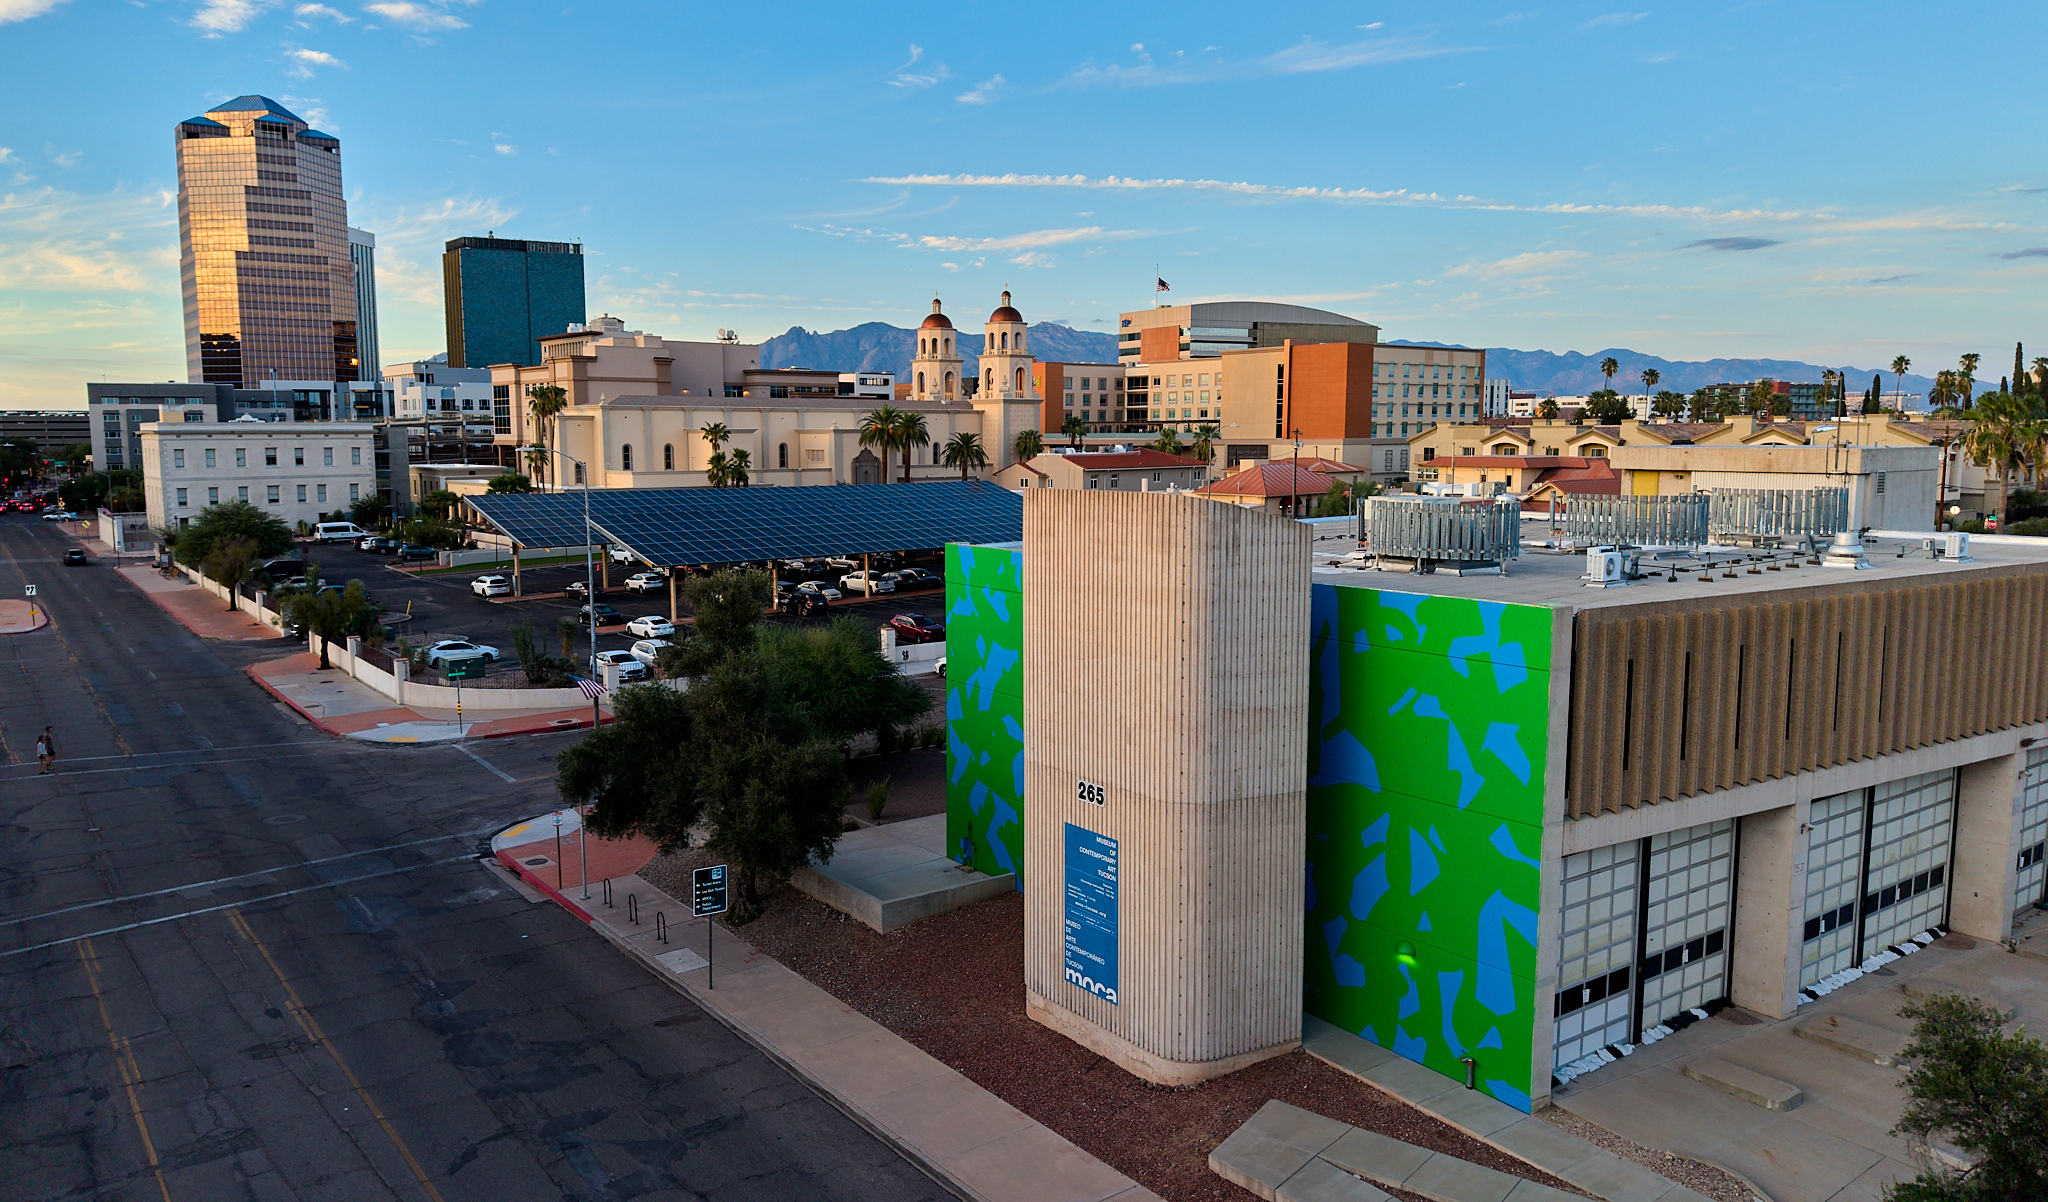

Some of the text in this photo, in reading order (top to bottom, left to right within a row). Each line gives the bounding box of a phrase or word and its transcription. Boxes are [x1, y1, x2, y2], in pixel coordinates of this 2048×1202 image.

[1078, 781, 1104, 805] 265
[1096, 836, 1116, 848] MUSEUM
[1079, 846, 1116, 865] CONTEMPORARY
[1097, 869, 1116, 881] TUCSON
[1107, 865, 1116, 873] ART
[1066, 918, 1081, 930] MUSEO
[1066, 934, 1076, 944] ARTE
